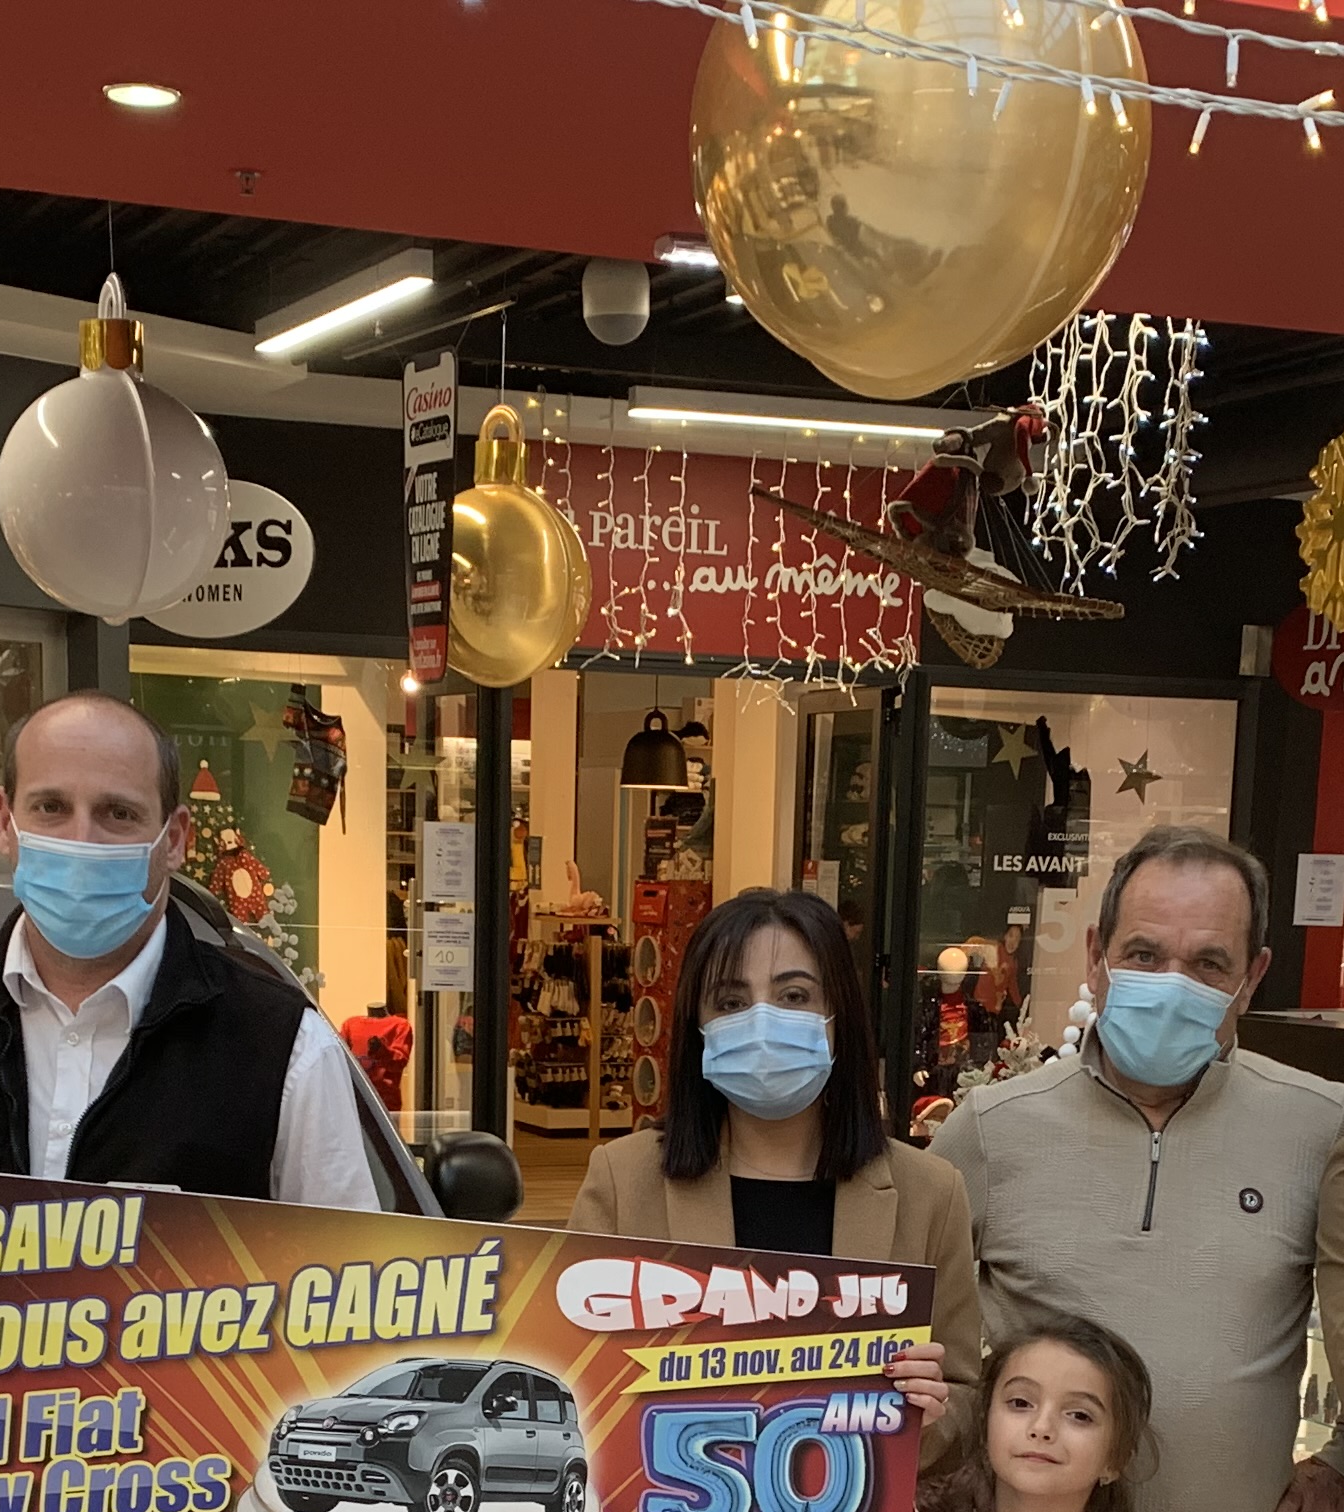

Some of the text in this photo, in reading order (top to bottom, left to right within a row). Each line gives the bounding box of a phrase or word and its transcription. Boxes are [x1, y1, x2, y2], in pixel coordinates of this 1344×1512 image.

[406, 382, 452, 421] Casino
[415, 472, 438, 504] VOTRE
[408, 501, 446, 534] CATALOGUE
[214, 519, 293, 568] KS
[764, 554, 904, 607] même
[993, 855, 1023, 872] LES
[435, 951, 455, 964] 10
[119, 1284, 277, 1360] avez
[285, 1238, 503, 1349] GAGNÉ
[556, 1256, 820, 1332] GRAND
[659, 1352, 694, 1383] du
[698, 1350, 725, 1379] 13
[732, 1351, 784, 1377] nov.
[791, 1349, 824, 1374] au
[828, 1338, 860, 1369] 24
[18, 1387, 145, 1463] Fiat
[820, 1391, 905, 1435] ANS
